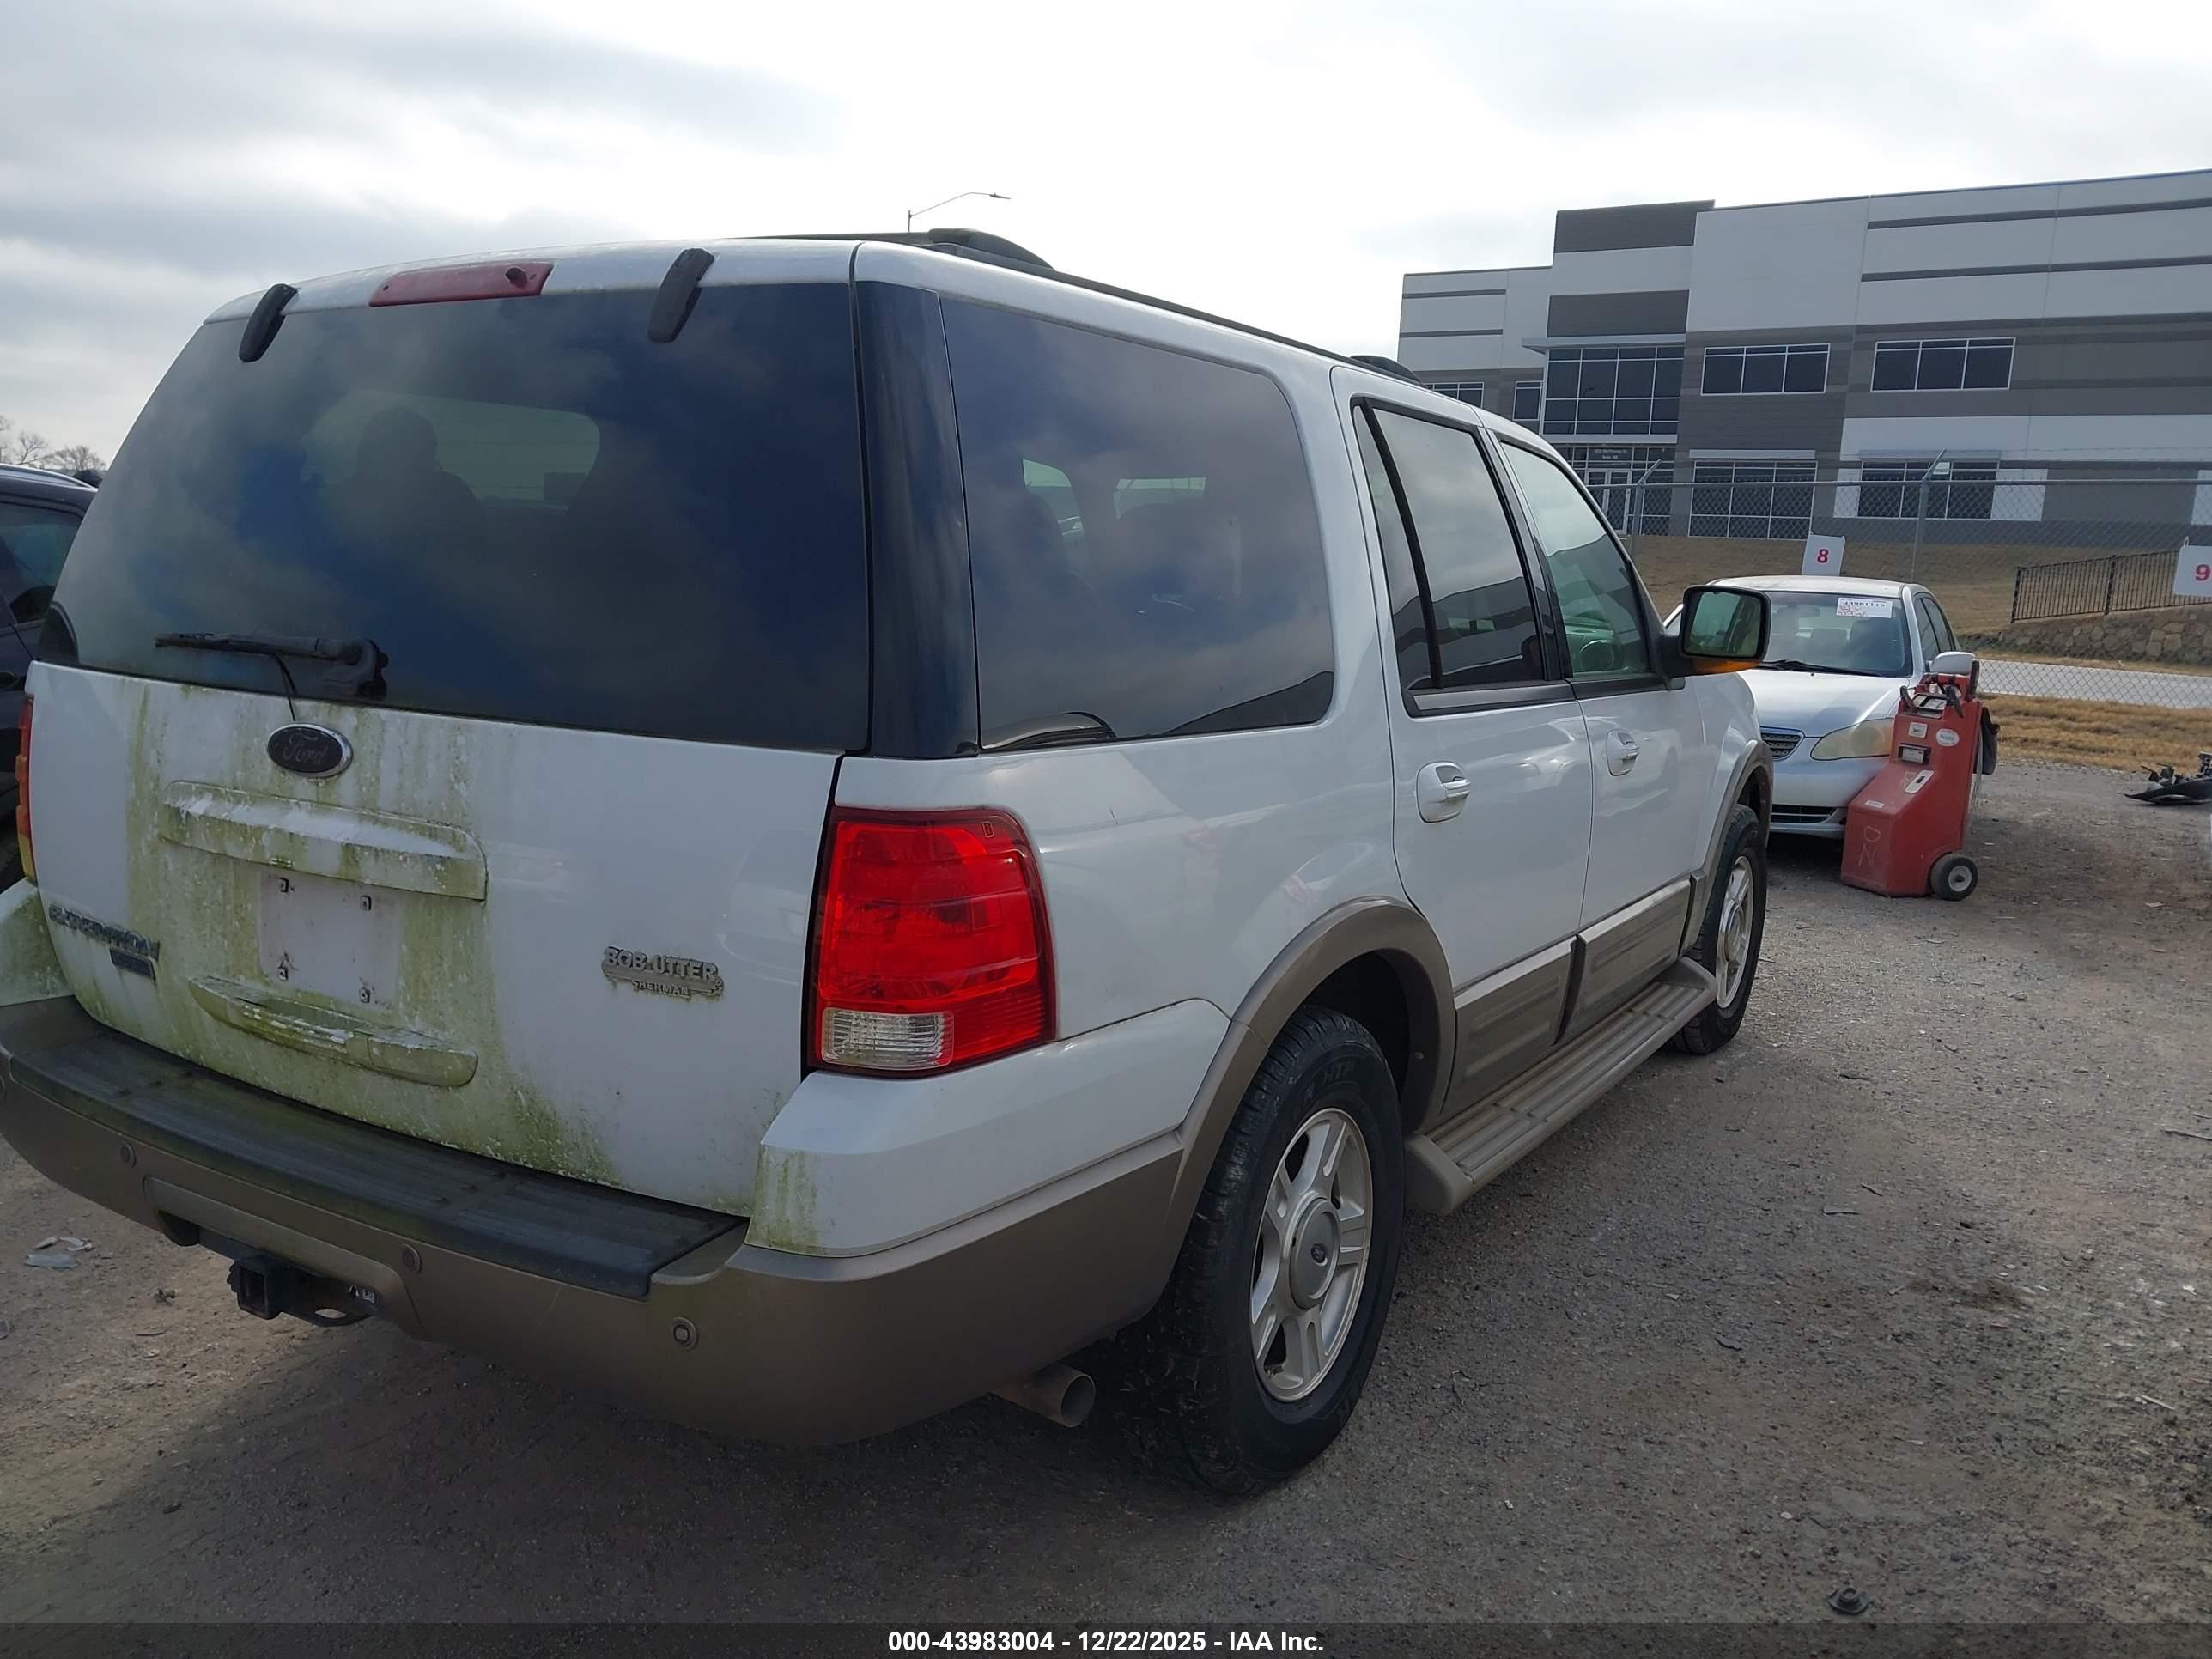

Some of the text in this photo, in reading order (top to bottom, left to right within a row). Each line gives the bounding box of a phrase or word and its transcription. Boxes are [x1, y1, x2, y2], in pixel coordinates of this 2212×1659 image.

[1817, 549, 1829, 563] 8
[2195, 563, 2211, 581] 9
[274, 733, 330, 764] Ford
[604, 945, 719, 981] BOB UTTER
[631, 979, 691, 999] SHERMAN
